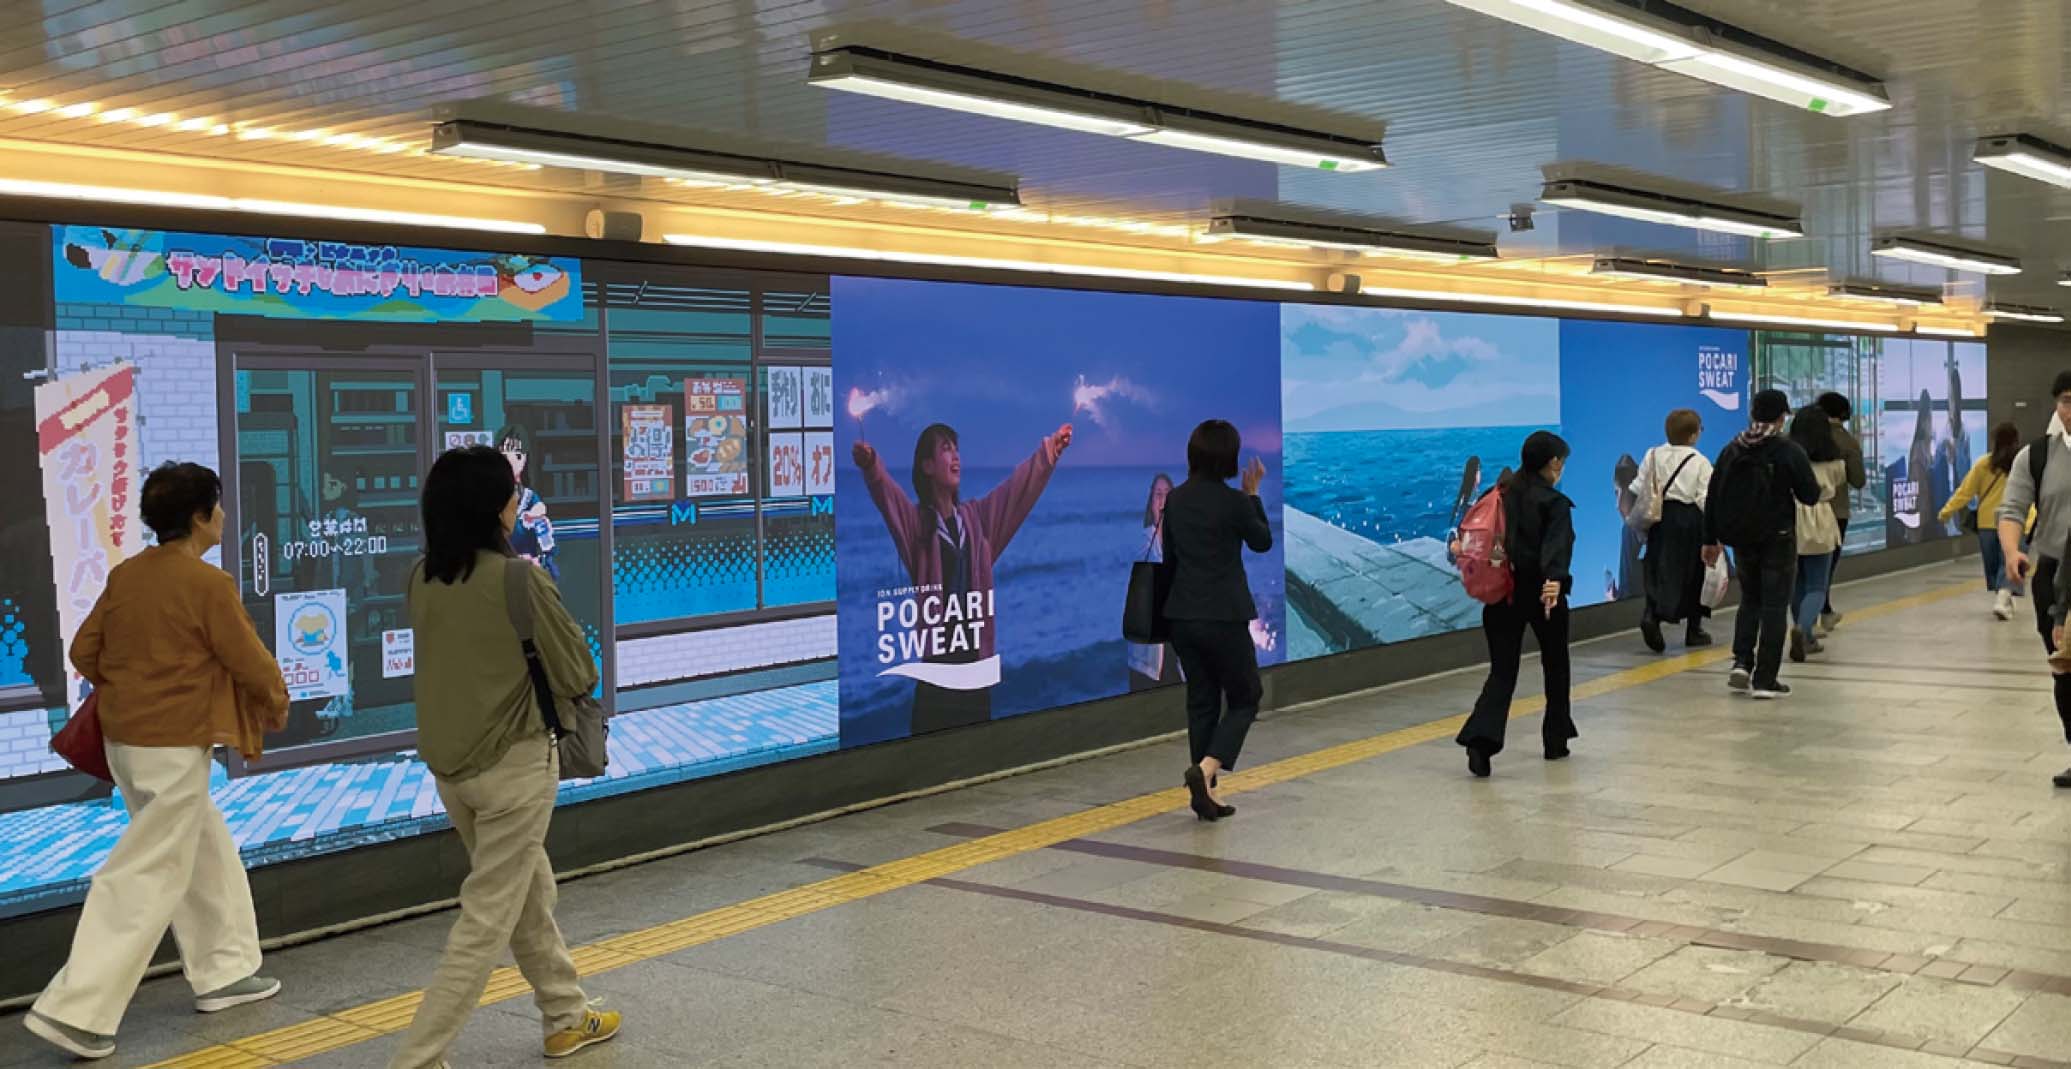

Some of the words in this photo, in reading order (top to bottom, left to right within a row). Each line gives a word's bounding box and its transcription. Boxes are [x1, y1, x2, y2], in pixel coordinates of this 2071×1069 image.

[1698, 352, 1737, 370] POCARI
[1698, 371, 1735, 388] SWEAT
[773, 446, 801, 486] 20%
[1892, 481, 1919, 498] POCARI
[877, 589, 995, 632] POCARI
[877, 621, 985, 664] SWEAT
